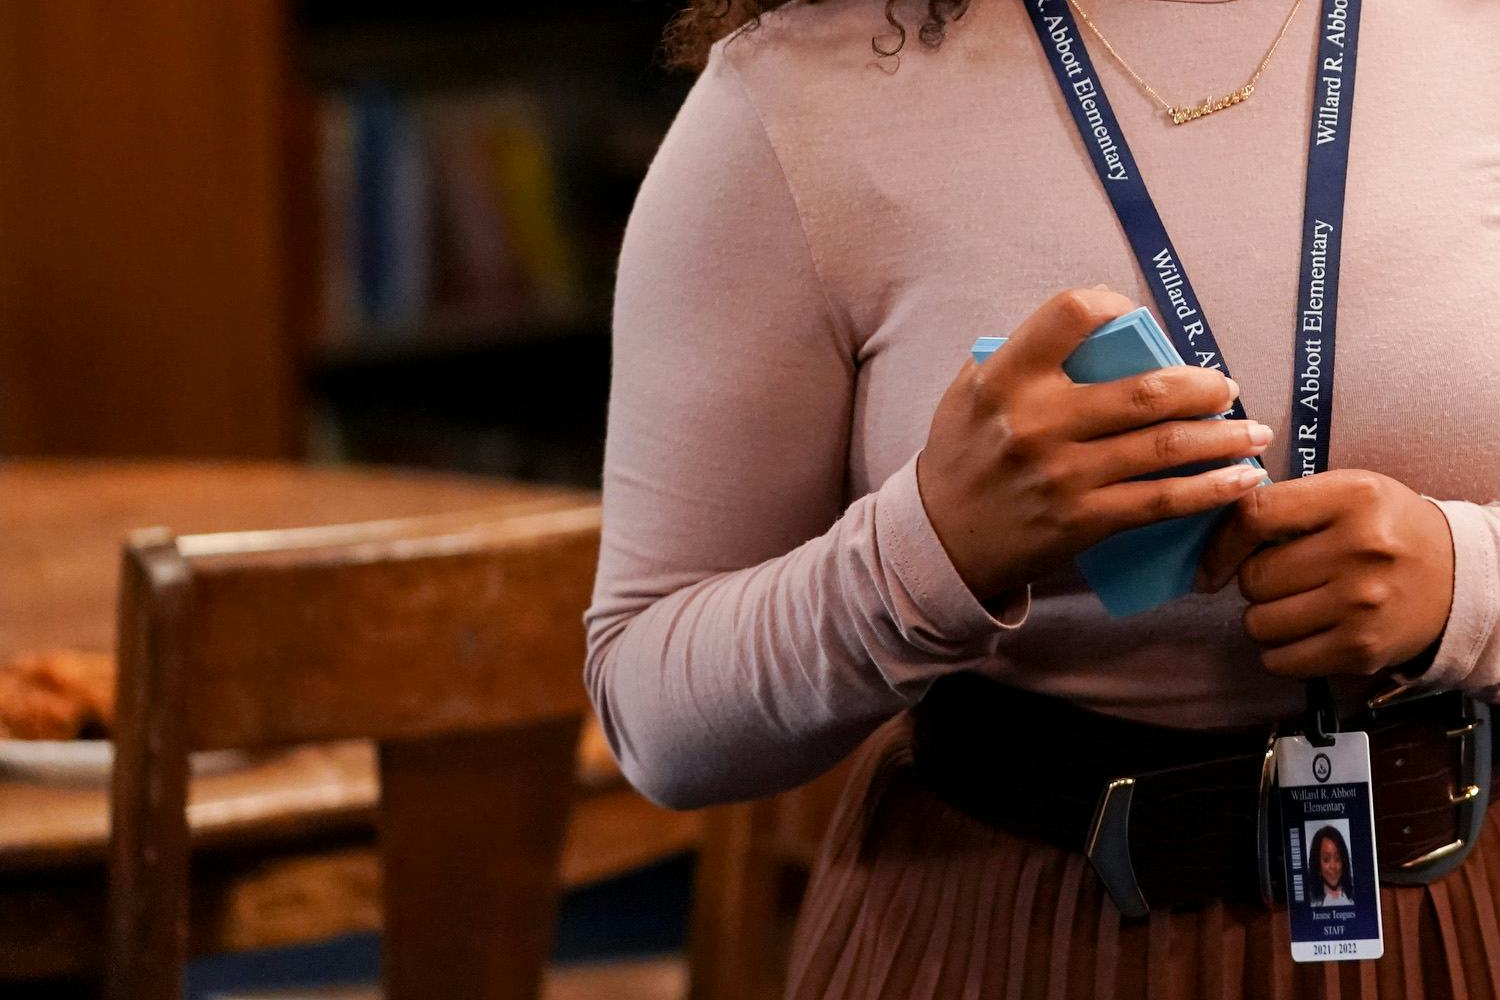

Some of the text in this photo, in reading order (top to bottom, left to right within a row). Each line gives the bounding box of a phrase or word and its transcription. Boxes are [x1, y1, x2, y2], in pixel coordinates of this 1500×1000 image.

[1323, 51, 1345, 74] R.
[1043, 14, 1084, 78] Abbott
[1072, 77, 1128, 180] Elementary
[1316, 75, 1342, 146] Willard
[1303, 219, 1334, 333] Elementary
[1152, 247, 1205, 347] Willard R.
[1299, 338, 1322, 412] Abbott
[1298, 417, 1319, 442] R.
[1291, 788, 1319, 800] Willard
[1331, 787, 1357, 798] Abbott
[1303, 801, 1346, 814] Elementary
[1323, 925, 1345, 936] STAFF
[1313, 944, 1331, 955] 2021
[1339, 942, 1357, 954] 2022
